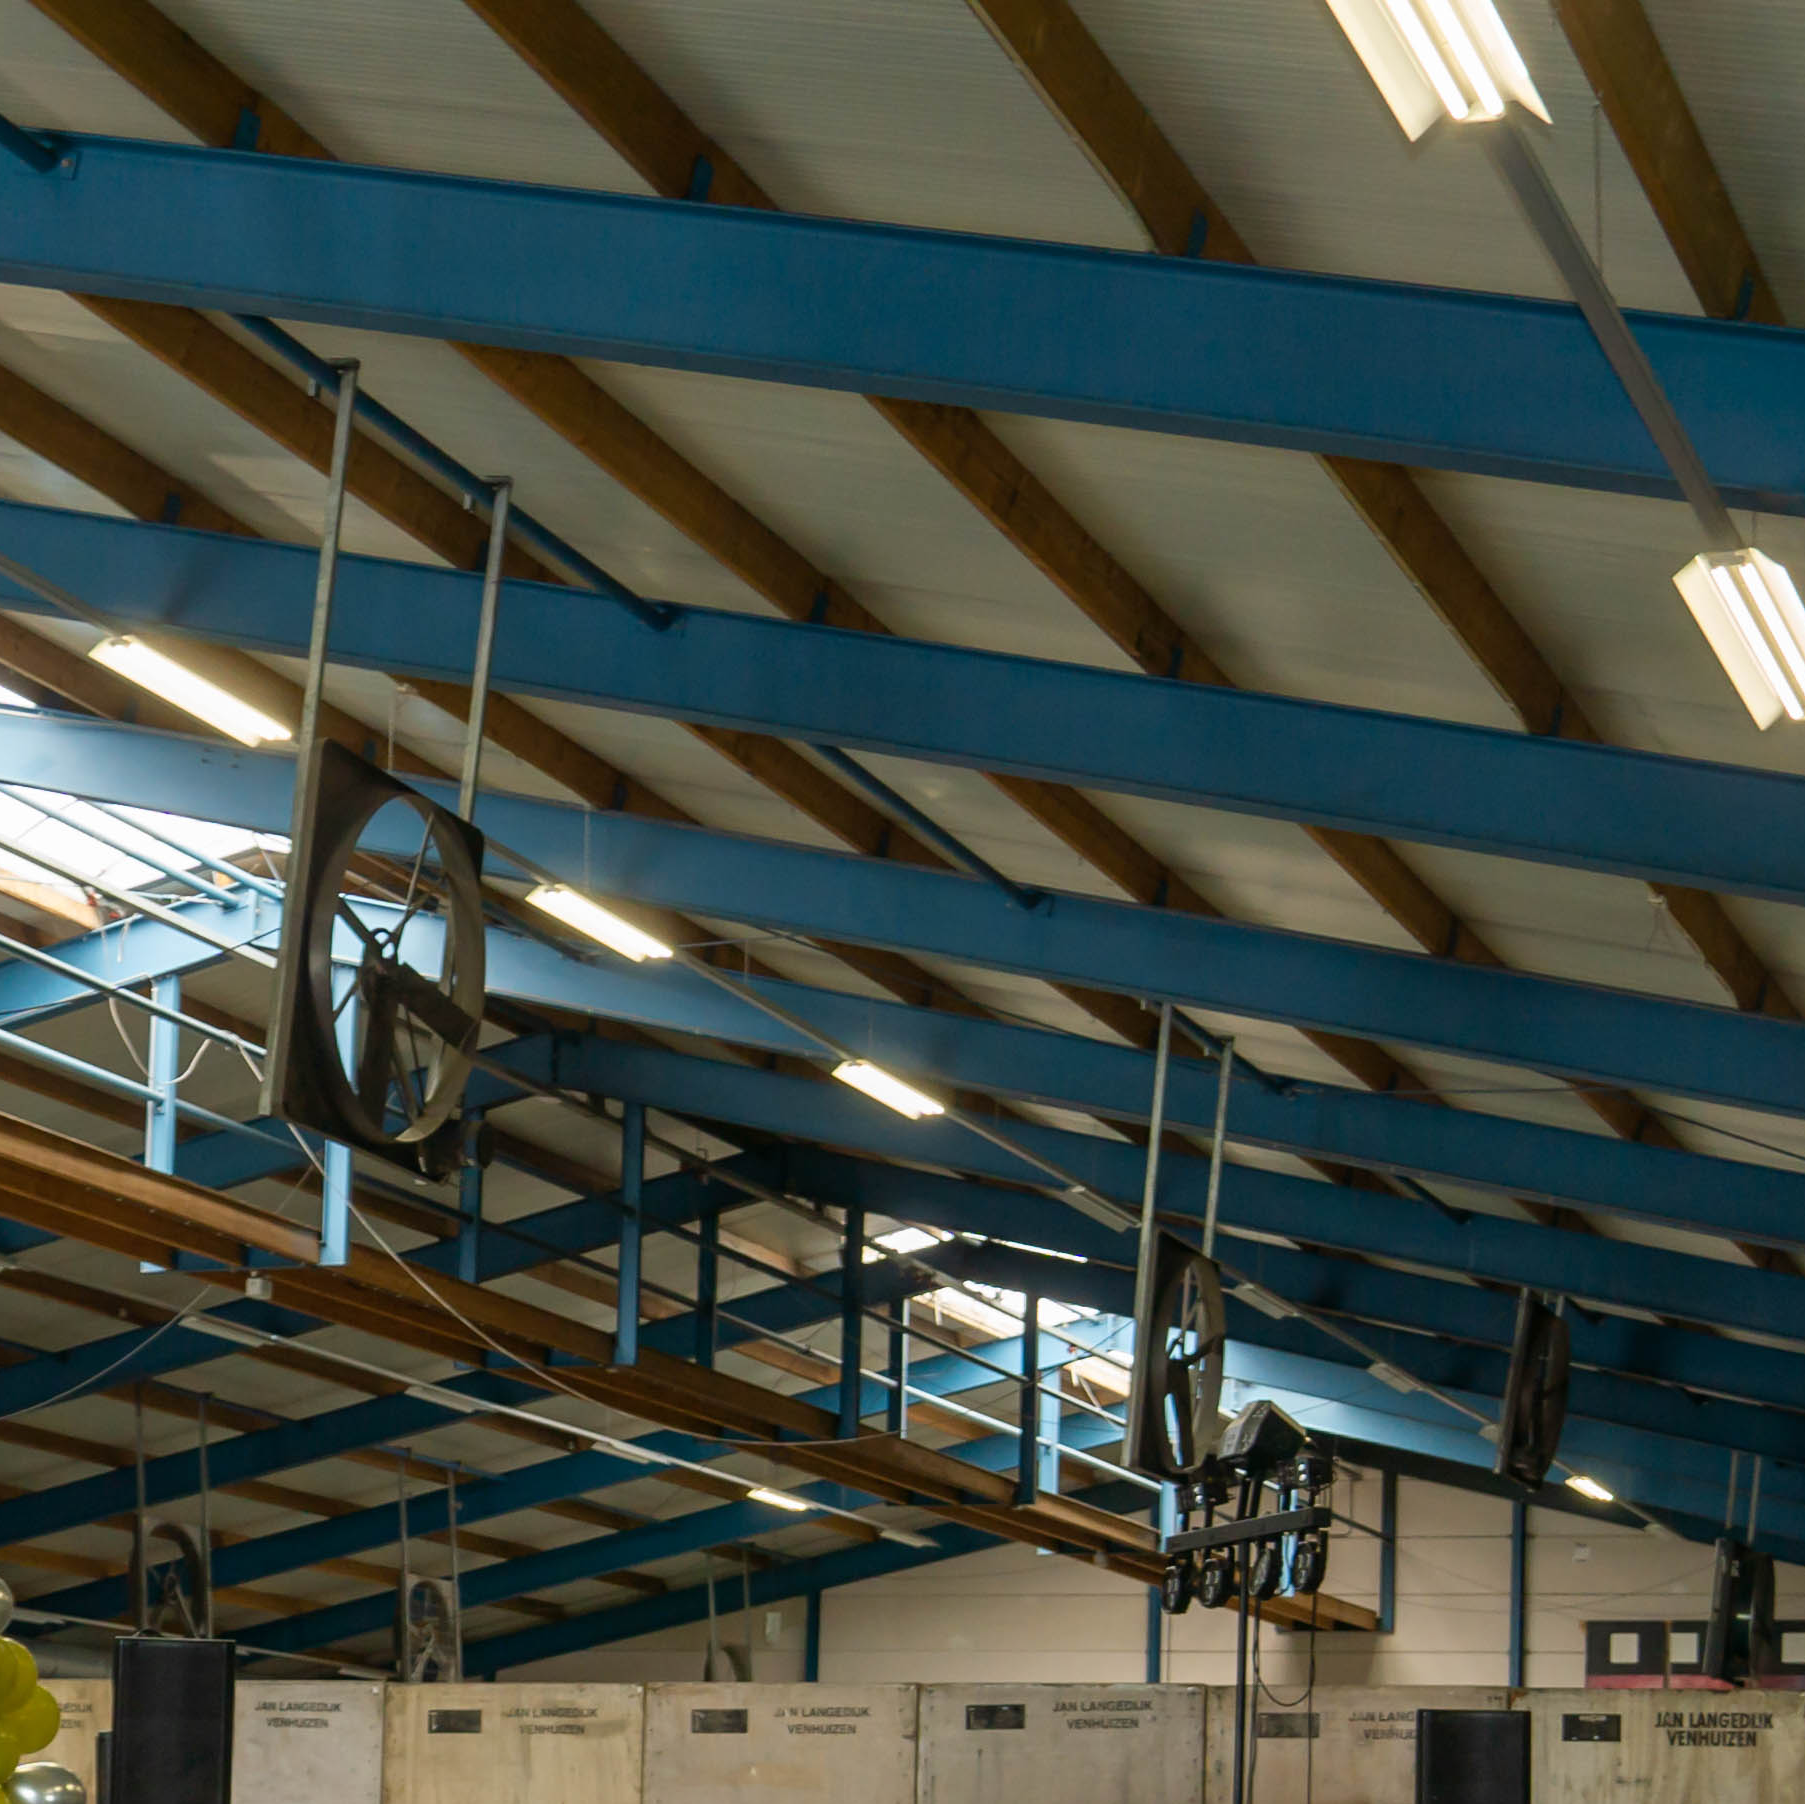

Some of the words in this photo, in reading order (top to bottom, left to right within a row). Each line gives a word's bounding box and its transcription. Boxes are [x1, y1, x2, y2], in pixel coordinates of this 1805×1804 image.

[1655, 1712, 1683, 1729] JAN
[1688, 1712, 1774, 1729] LANGEDIJK
[1666, 1731, 1757, 1747] VENHUIZEN
